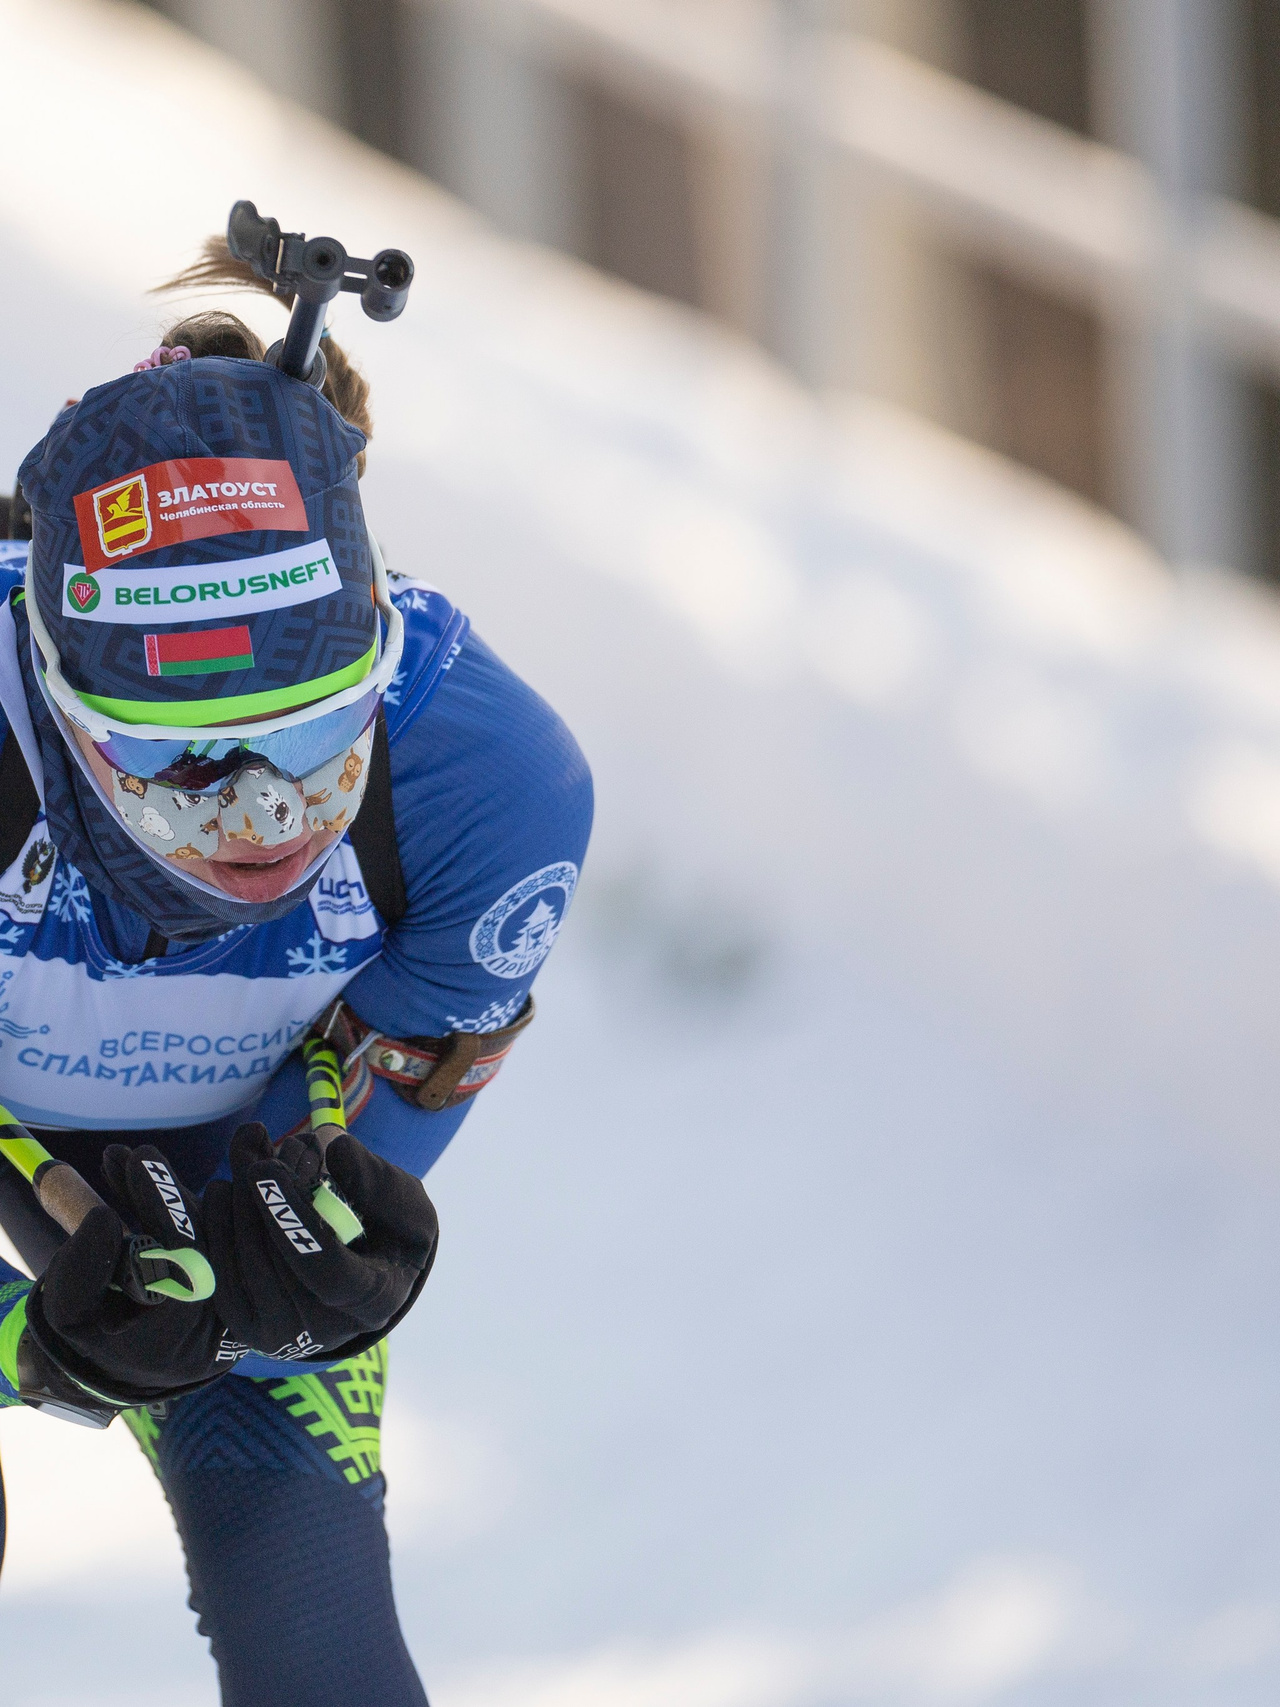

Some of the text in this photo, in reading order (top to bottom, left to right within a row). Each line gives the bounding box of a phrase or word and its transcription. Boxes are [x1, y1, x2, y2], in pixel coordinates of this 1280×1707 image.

[157, 482, 277, 508] ЗЛАТОУСТ
[159, 500, 286, 522] Челябинская область
[114, 557, 332, 605] BELORUSNEFT
